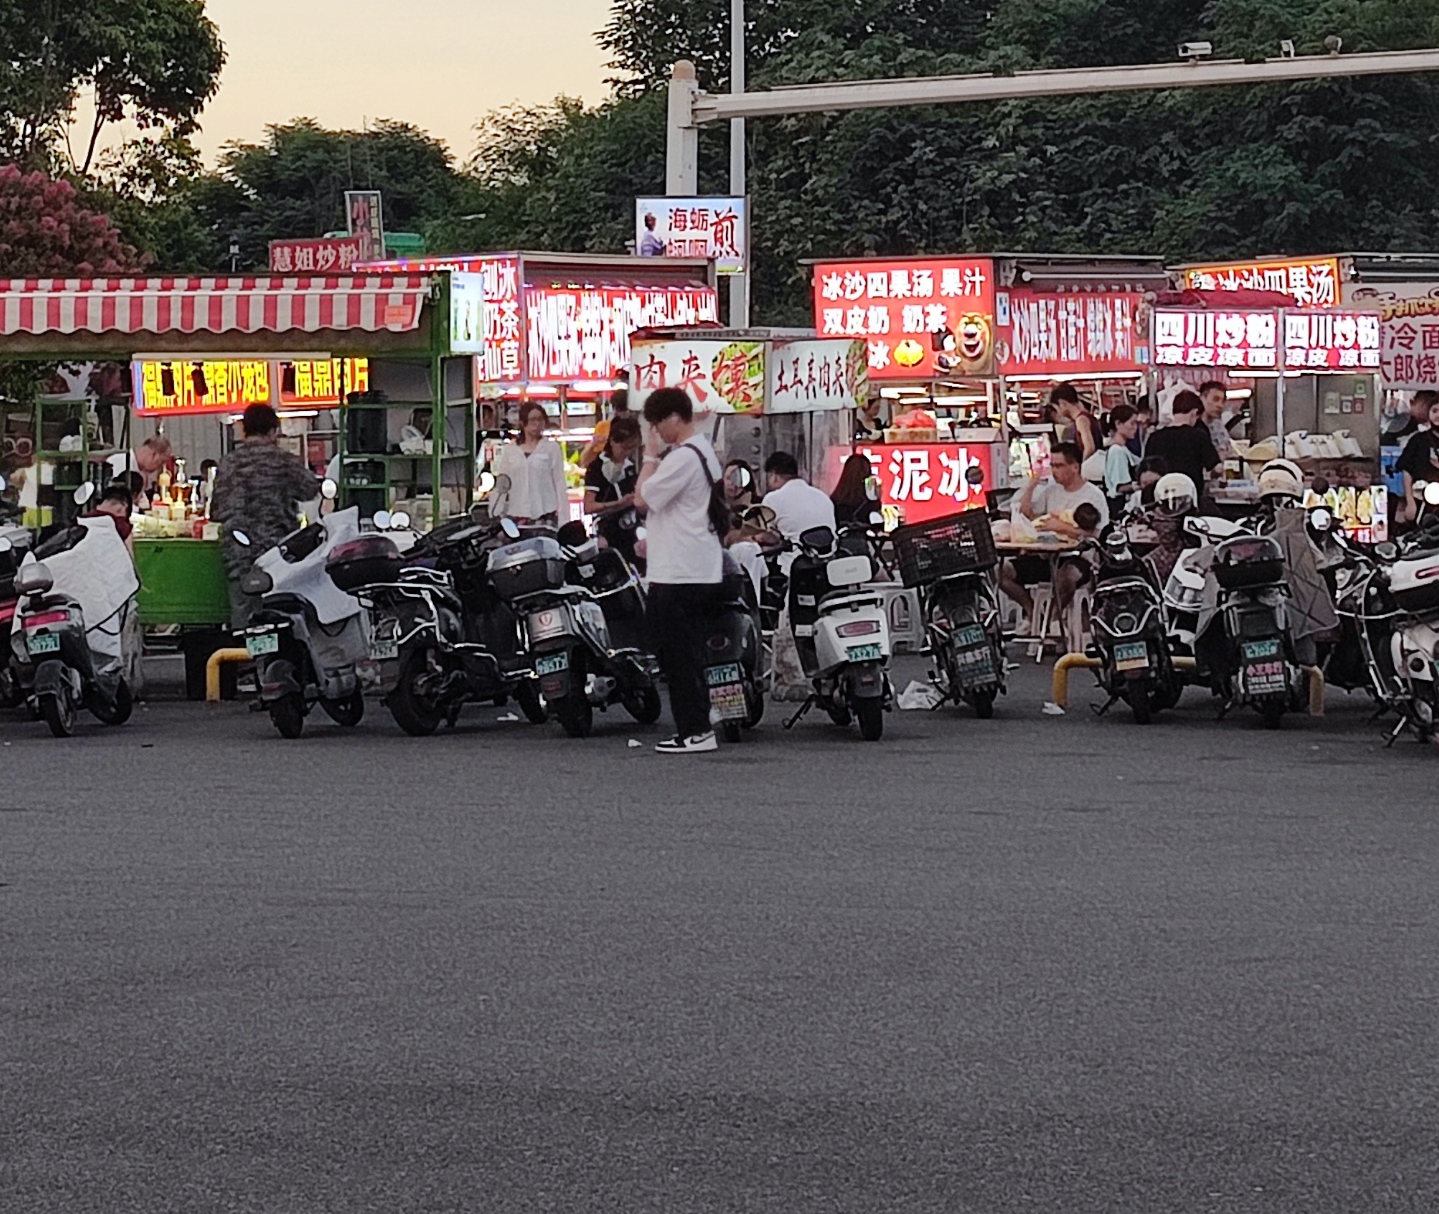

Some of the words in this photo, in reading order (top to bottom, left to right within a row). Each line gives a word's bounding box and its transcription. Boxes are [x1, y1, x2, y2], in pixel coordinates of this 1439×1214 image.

[668, 207, 709, 231] 海蛎
[272, 243, 359, 272] 慧姐炒粉
[821, 270, 934, 301] 冰沙四果汤
[940, 266, 986, 298] 果汁
[823, 305, 891, 335] 双皮奶
[902, 303, 948, 334] 奶茶
[1155, 312, 1277, 348] 四川炒粉
[1285, 314, 1381, 349] 四川炒粉
[867, 340, 891, 370] 冰
